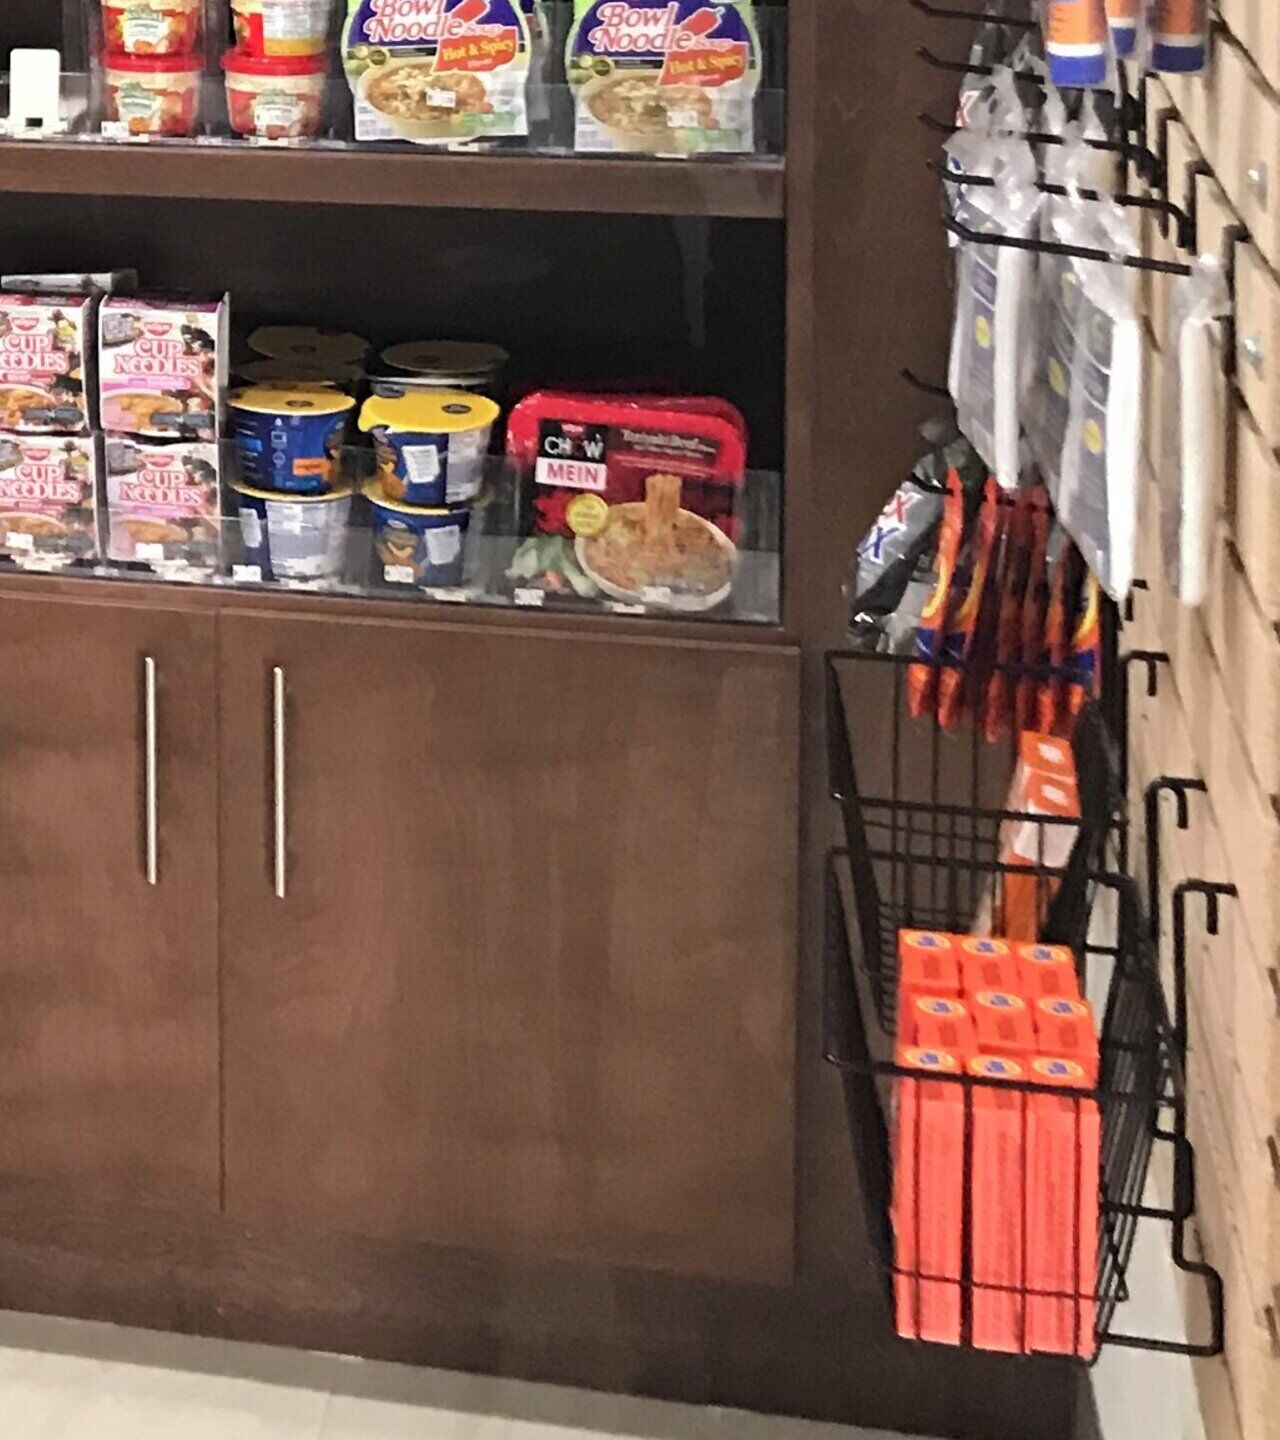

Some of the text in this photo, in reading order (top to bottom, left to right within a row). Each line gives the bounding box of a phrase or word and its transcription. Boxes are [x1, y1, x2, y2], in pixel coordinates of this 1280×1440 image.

[598, 2, 678, 28] Bowl
[365, 16, 463, 40] Noodle
[590, 27, 694, 51] Noodle
[4, 334, 52, 352] CUP
[135, 338, 184, 358] CUP
[16, 464, 64, 482] CUP
[138, 470, 187, 489] CUP
[547, 461, 599, 485] MEIN
